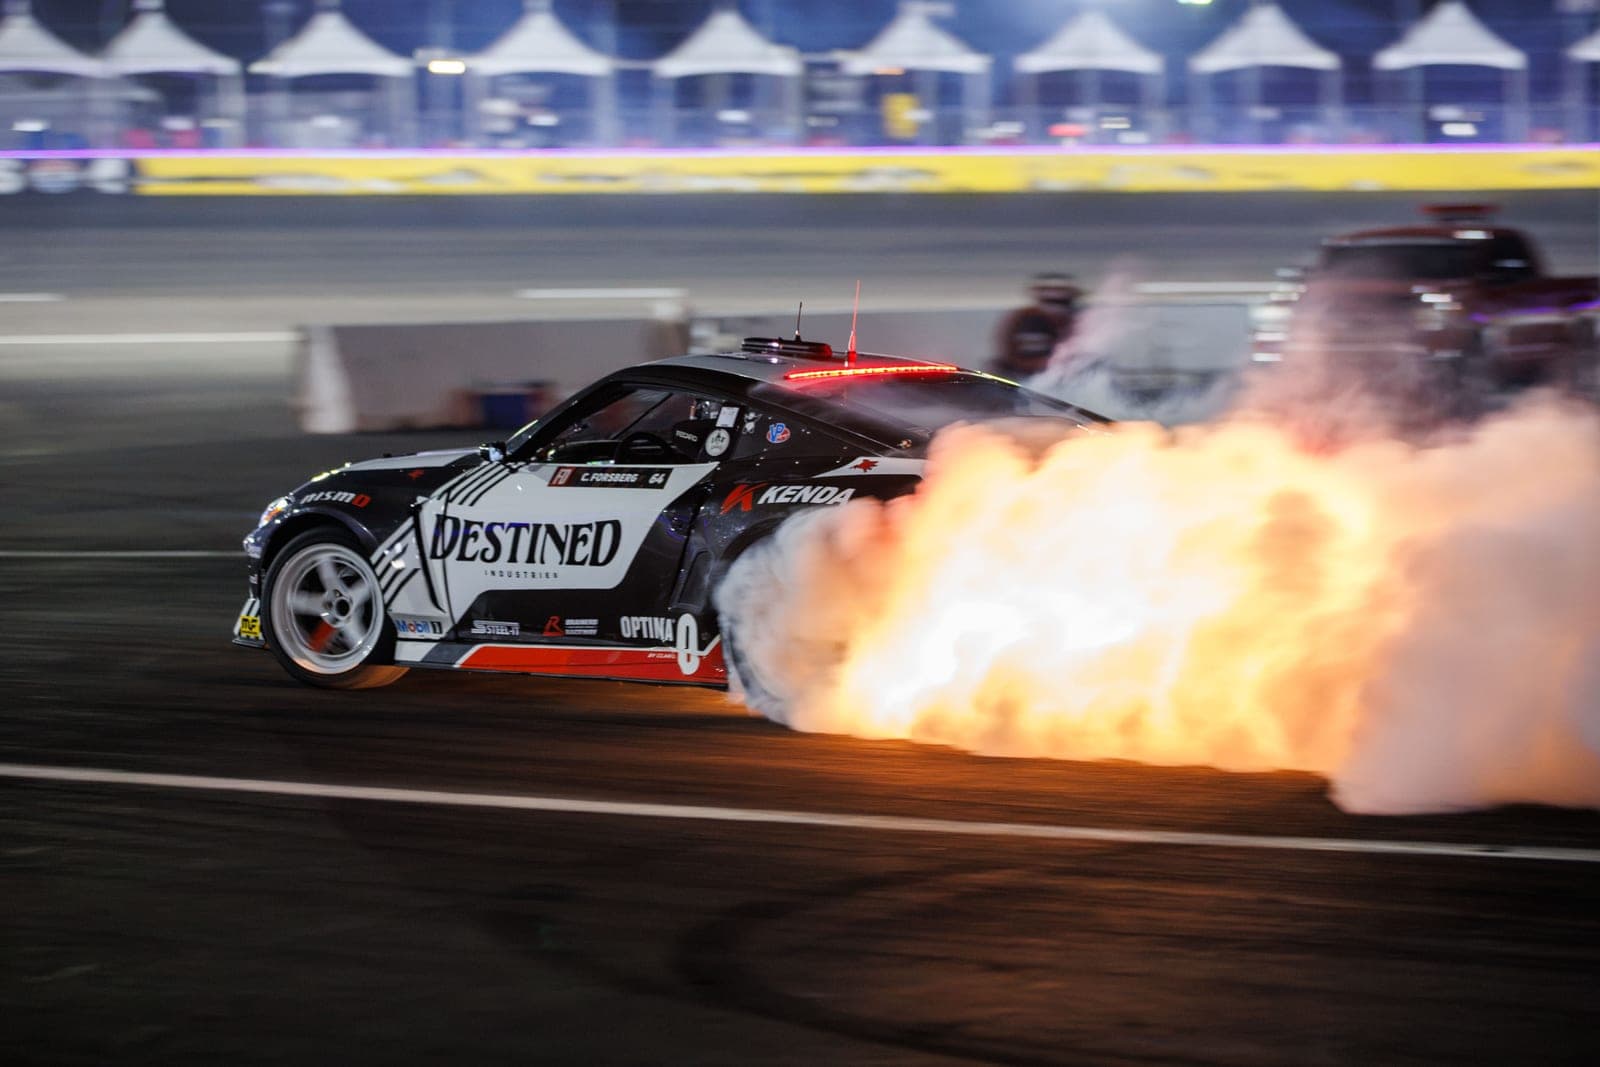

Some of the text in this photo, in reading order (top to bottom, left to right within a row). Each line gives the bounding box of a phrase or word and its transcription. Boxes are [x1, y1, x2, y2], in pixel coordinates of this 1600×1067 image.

[757, 485, 857, 505] KENDA
[429, 513, 622, 567] DESTINED
[484, 569, 559, 579] INDUSTRIES
[396, 619, 443, 634] Mobil 1
